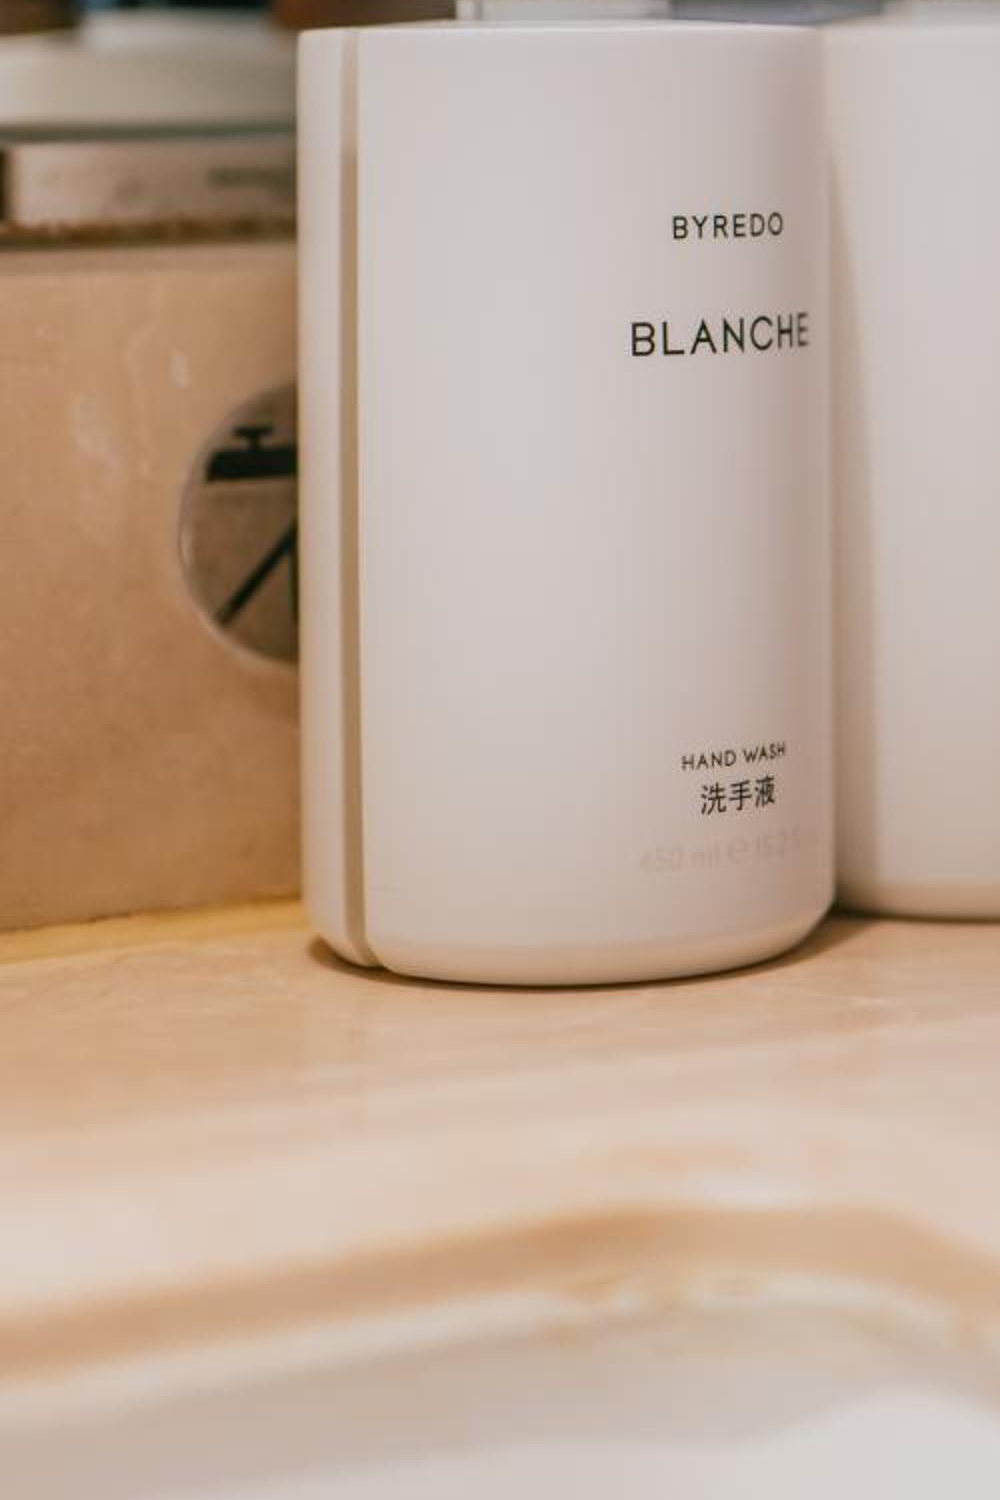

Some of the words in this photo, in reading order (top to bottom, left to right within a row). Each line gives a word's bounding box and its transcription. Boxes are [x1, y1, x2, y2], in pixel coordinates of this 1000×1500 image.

[672, 211, 784, 240] BYREDO
[631, 311, 810, 357] BLANCHE
[681, 749, 737, 771] HAND
[743, 740, 787, 764] WASH
[701, 774, 776, 816] 洗手液
